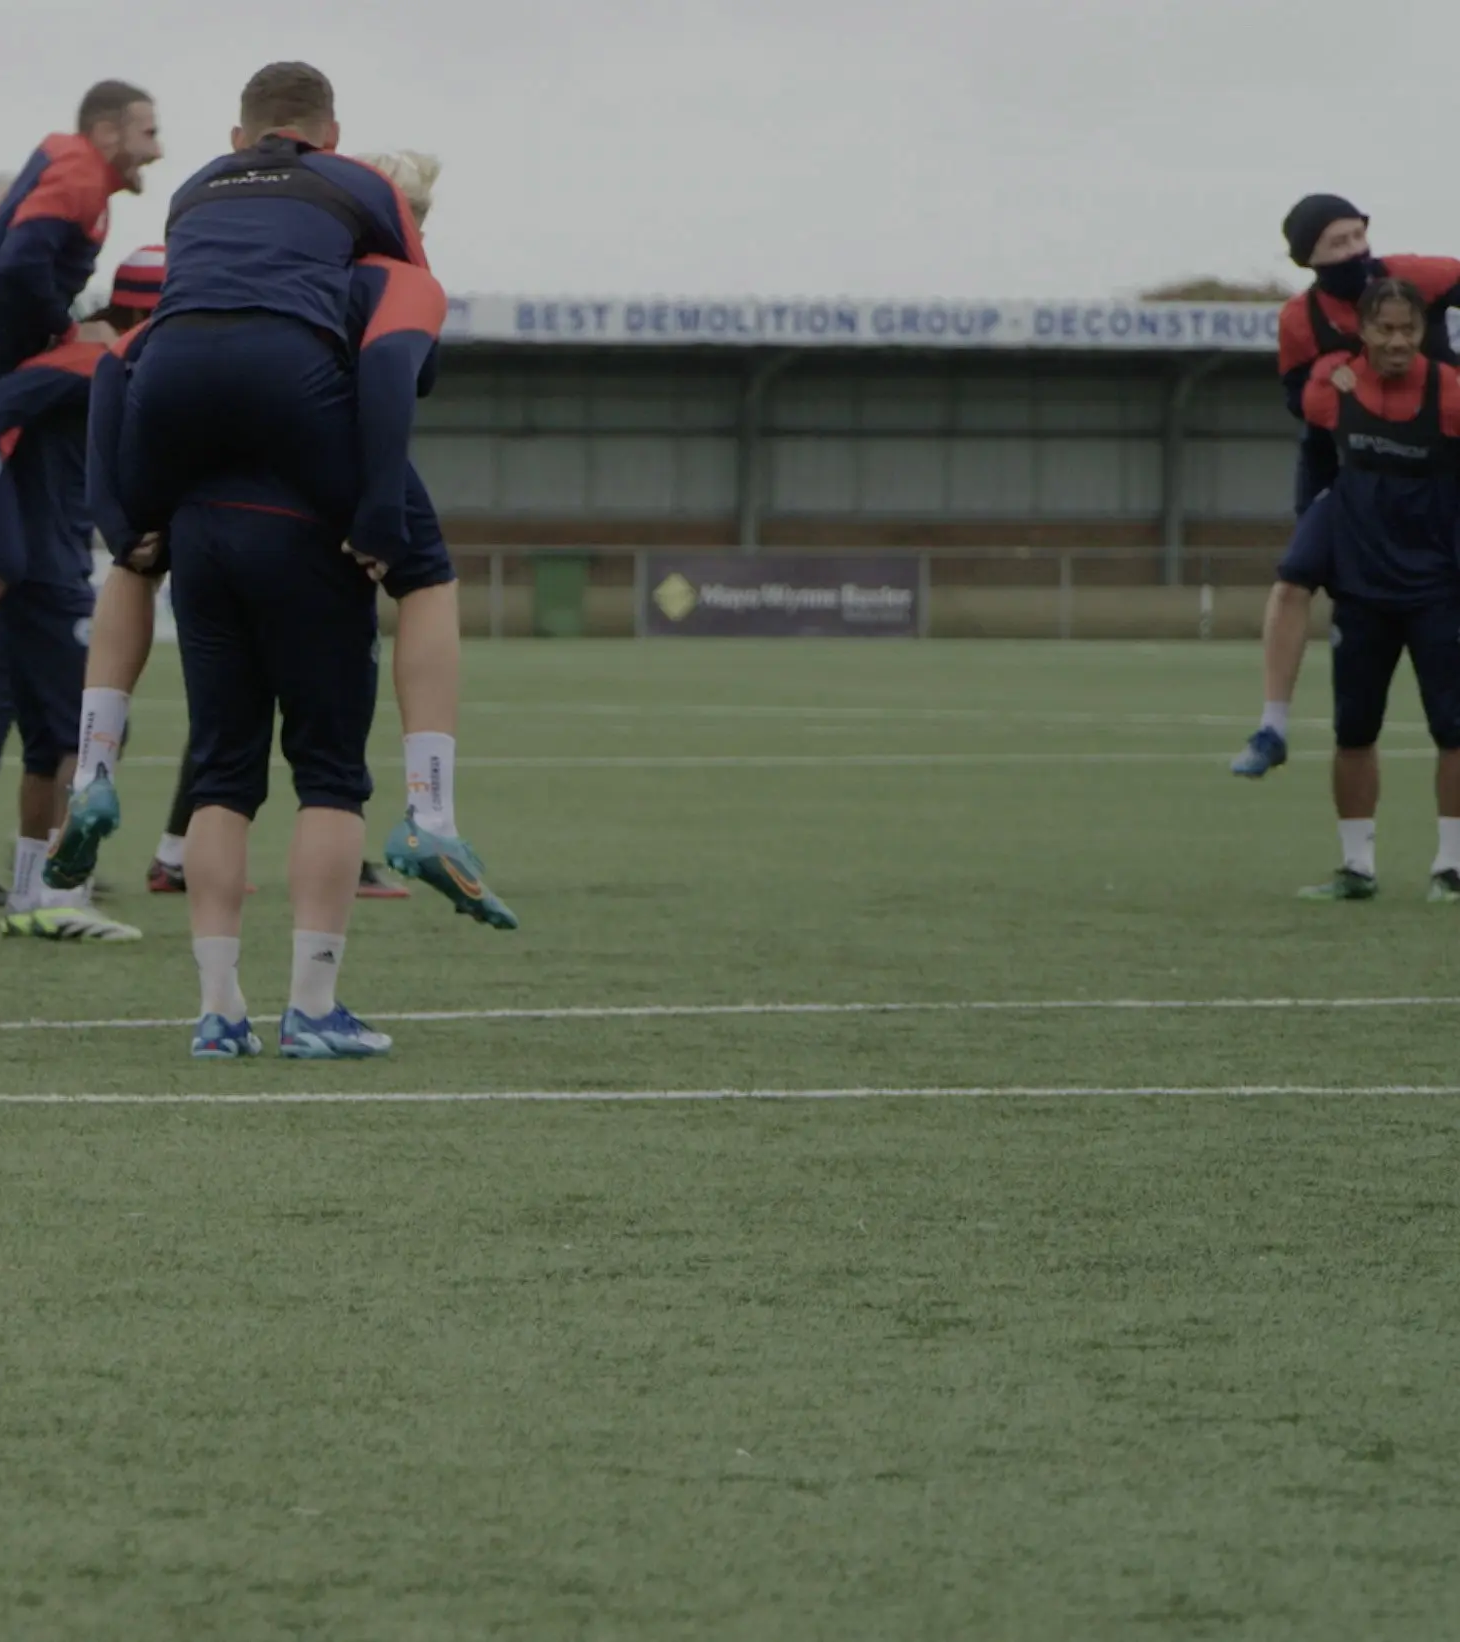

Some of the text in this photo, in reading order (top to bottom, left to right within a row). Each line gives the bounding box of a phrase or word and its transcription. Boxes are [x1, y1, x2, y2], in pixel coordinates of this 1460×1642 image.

[516, 301, 609, 331] BEST
[625, 302, 858, 333] DEMOLITION
[870, 306, 1000, 336] GROUP
